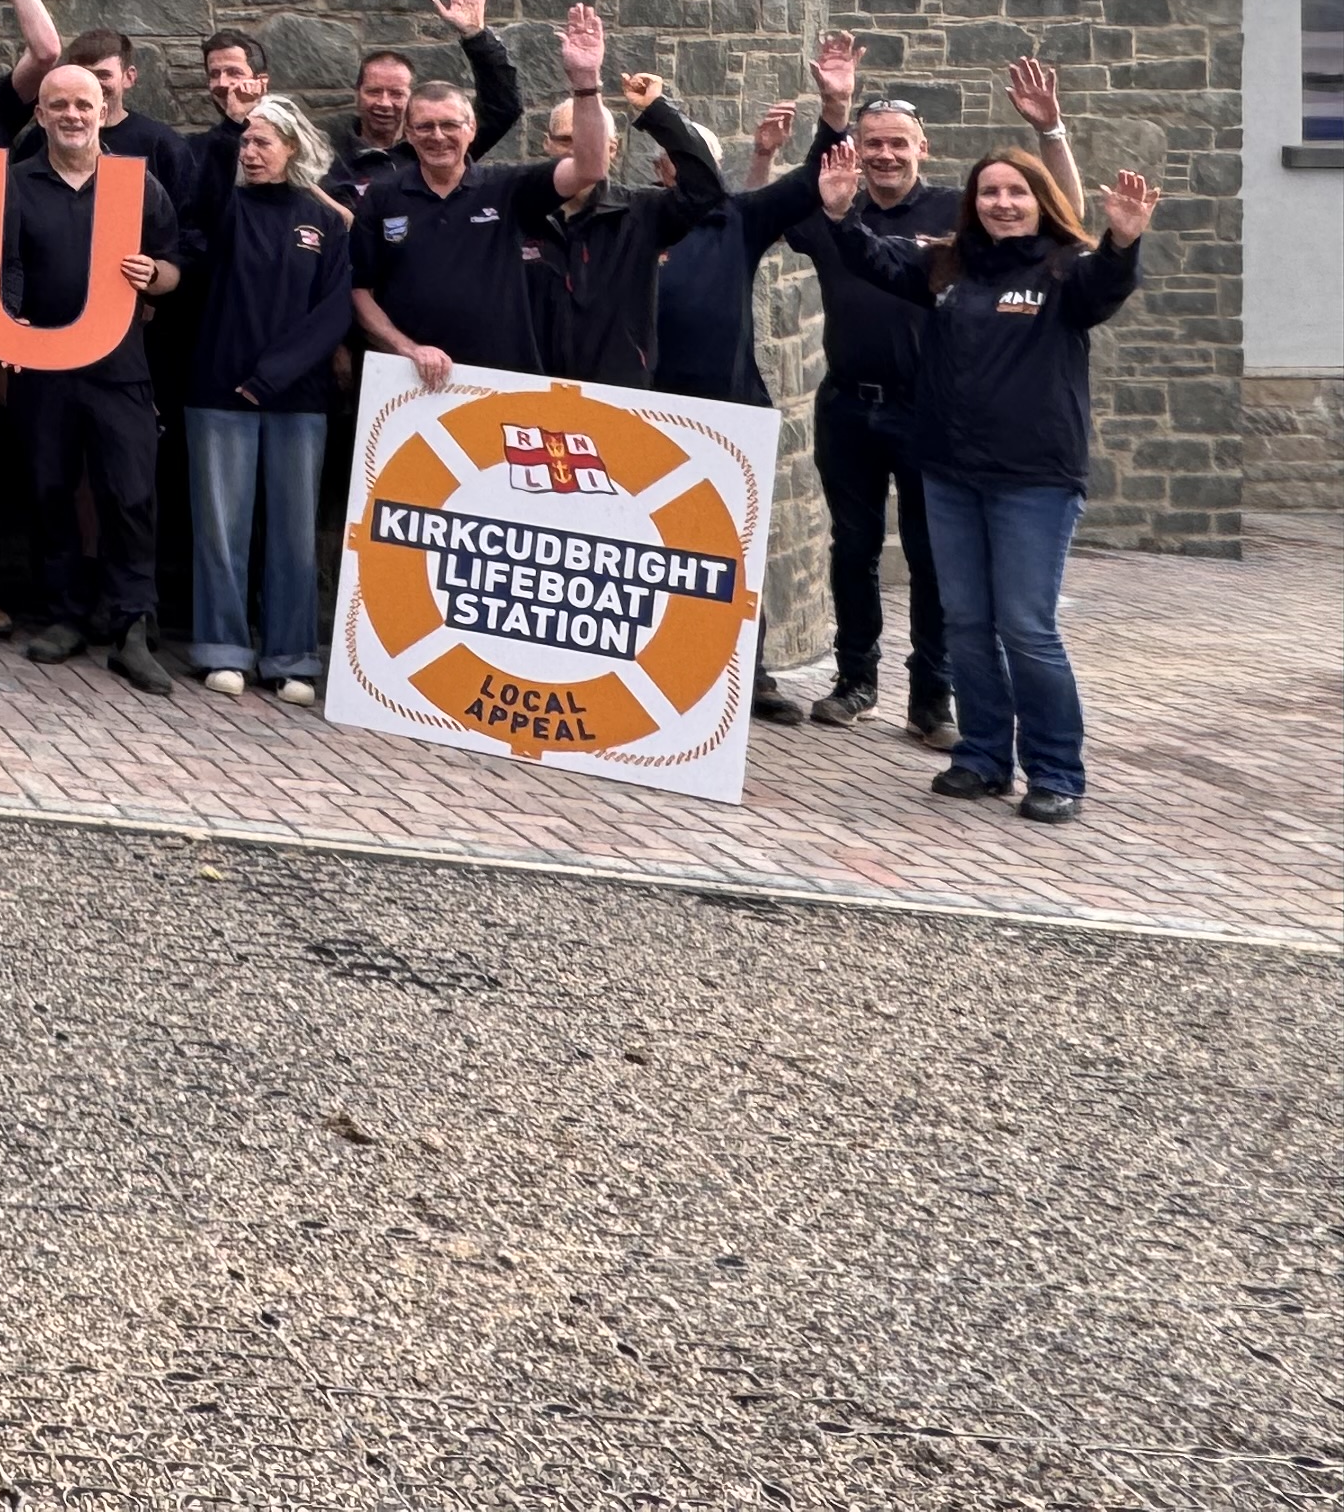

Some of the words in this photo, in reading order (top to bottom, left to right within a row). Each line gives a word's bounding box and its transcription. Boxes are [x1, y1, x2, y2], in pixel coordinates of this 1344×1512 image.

[516, 429, 533, 448] R
[572, 434, 590, 452] N
[524, 468, 541, 488] L
[378, 505, 728, 595] KIRKCUDBRIGHT
[444, 553, 651, 618] LIFEBOAT
[453, 591, 632, 655] STATION
[479, 674, 587, 714] LOCAL
[463, 696, 596, 741] APPEAL
